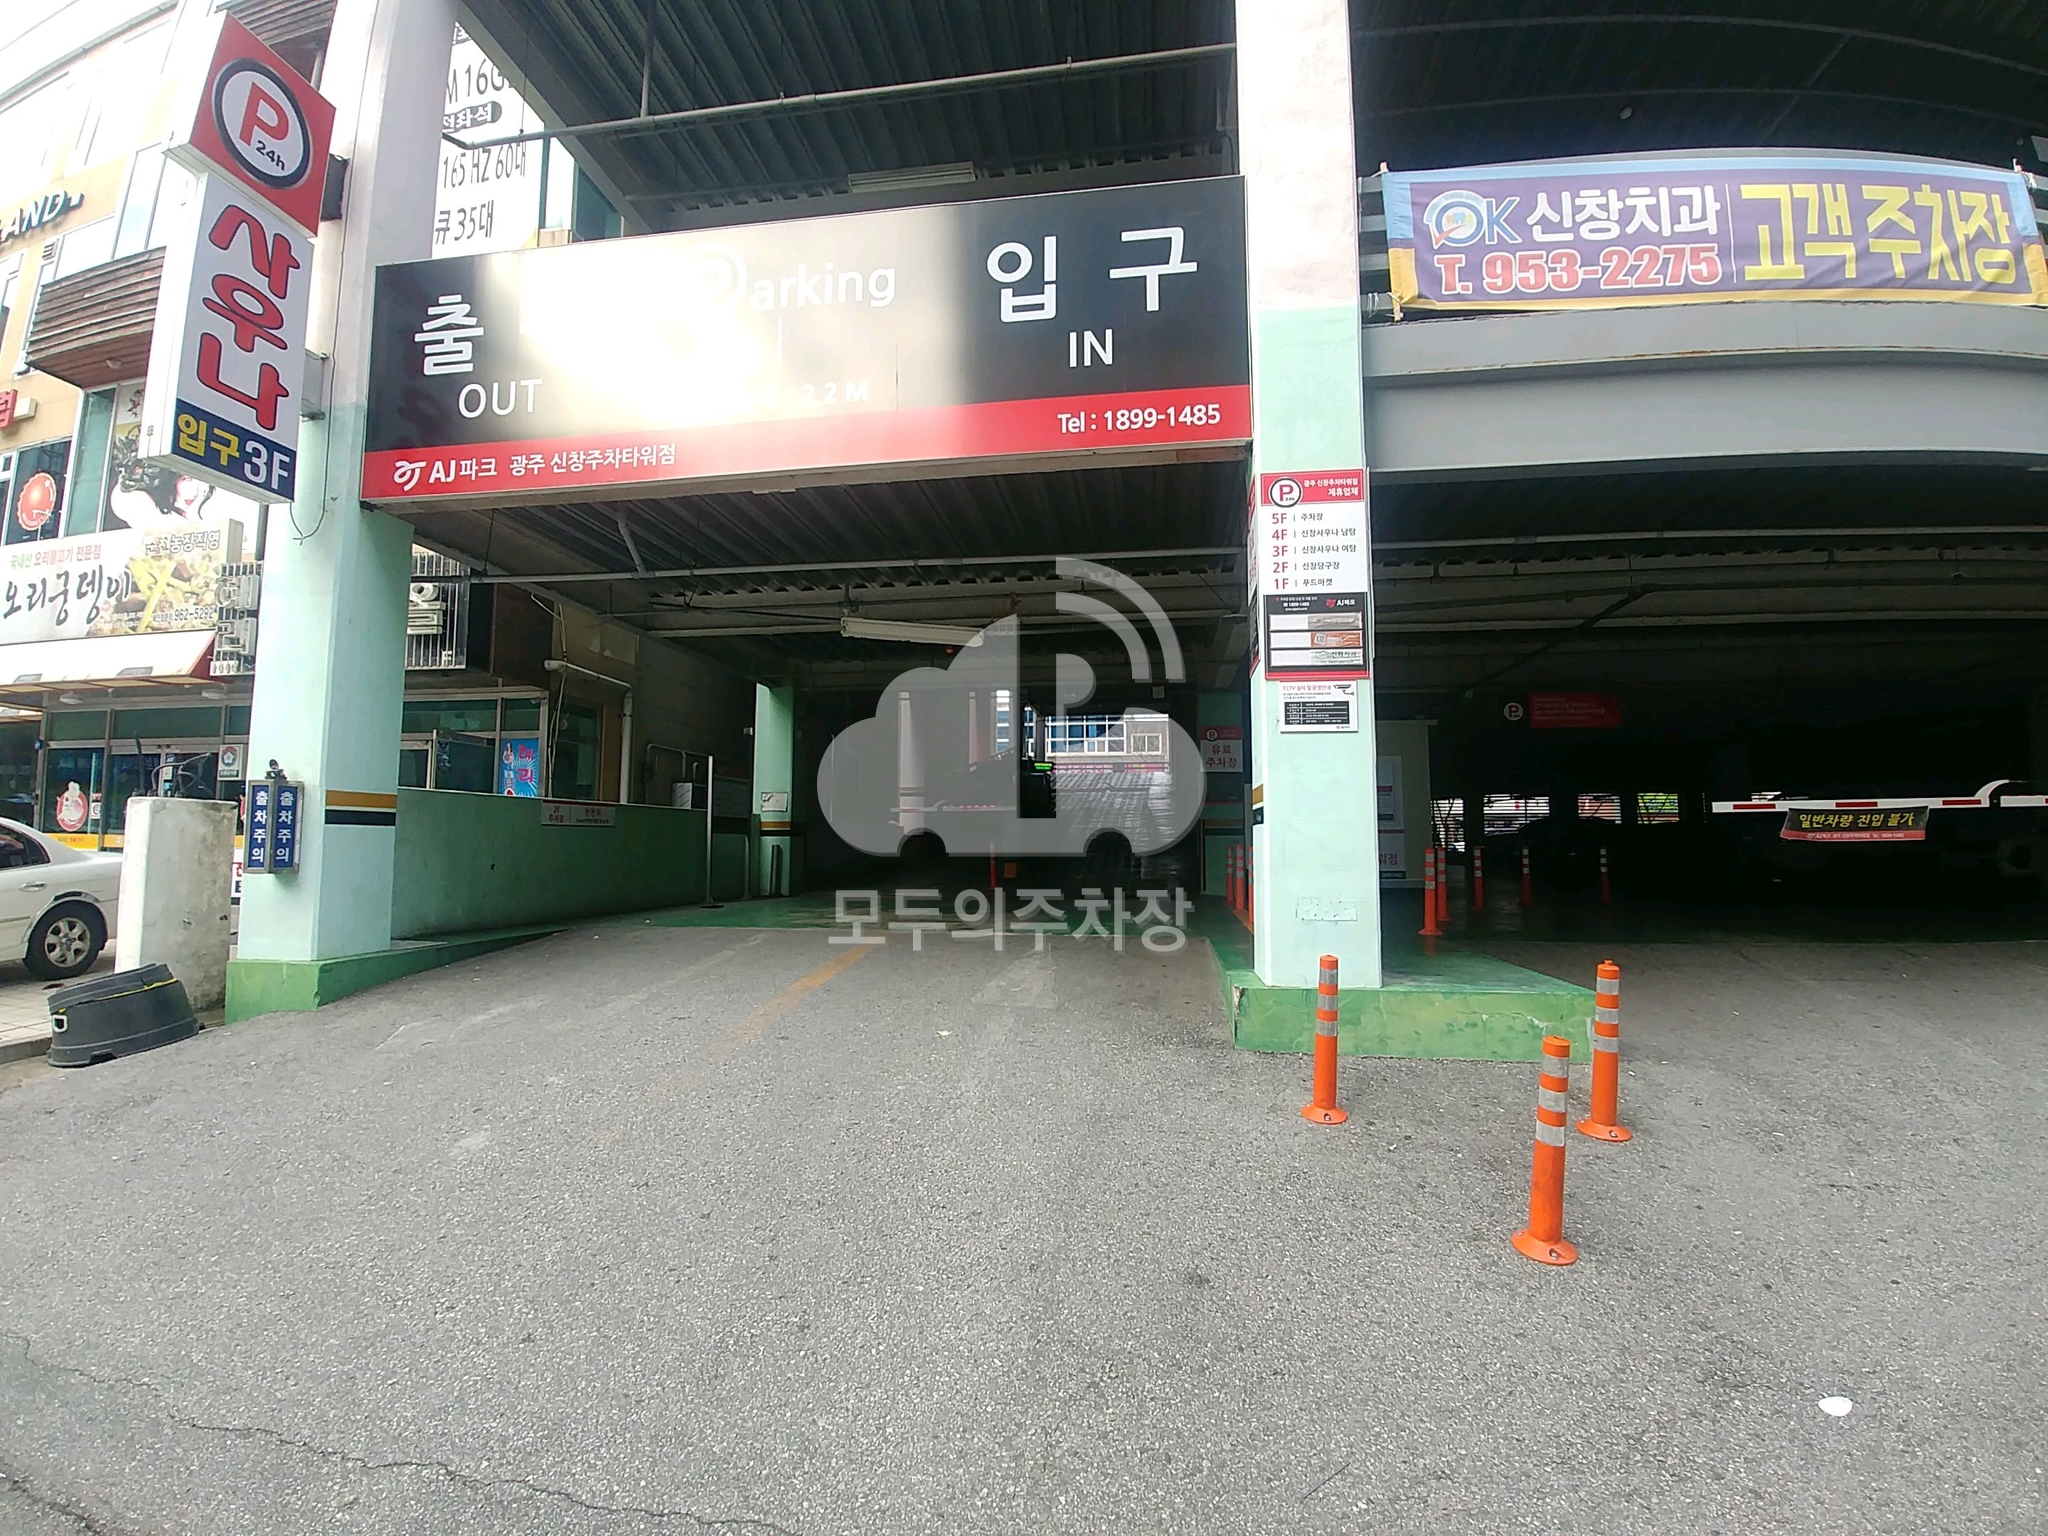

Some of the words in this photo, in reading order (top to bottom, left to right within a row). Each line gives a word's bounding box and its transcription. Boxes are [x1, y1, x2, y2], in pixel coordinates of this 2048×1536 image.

[239, 81, 289, 147] P
[255, 139, 286, 171] 24h
[443, 151, 466, 189] 165
[454, 199, 494, 242] 35대
[1526, 185, 1722, 243] 신창치과
[1740, 182, 1858, 281] 고객
[1861, 183, 2017, 285] 주차장
[1481, 243, 1723, 294] 953-2275
[197, 203, 300, 432] 사우나
[414, 294, 485, 376] 출
[1068, 328, 1114, 368] IN
[458, 378, 543, 419] OUT
[1103, 403, 1222, 431] 1899-1485
[177, 412, 241, 466] 입구
[243, 442, 290, 491] 3F
[428, 457, 498, 484] AJ파크
[509, 454, 546, 477] 광주
[550, 443, 676, 474] 신창주차타워점
[1279, 484, 1294, 502] P
[1272, 513, 1287, 524] 5F
[1301, 513, 1323, 521] 주차장
[1272, 529, 1287, 540] 4F
[1301, 528, 1339, 538] 신창사우나
[1273, 545, 1288, 557] 3F
[1302, 544, 1339, 554] 신창사우나
[1342, 544, 1356, 553] 여탕
[1273, 562, 1288, 573] 2F
[1302, 561, 1340, 570] 신창당구장
[1274, 578, 1289, 589] 1F
[174, 605, 214, 622] 962-5292
[1206, 757, 1237, 769] 주차장
[1211, 744, 1231, 755] 유료
[251, 791, 269, 863] 출차주의
[275, 791, 295, 863] 출차주의
[1800, 814, 1853, 828] 일반차량
[1857, 813, 1884, 828] 진입
[1887, 811, 1914, 827] 불가
